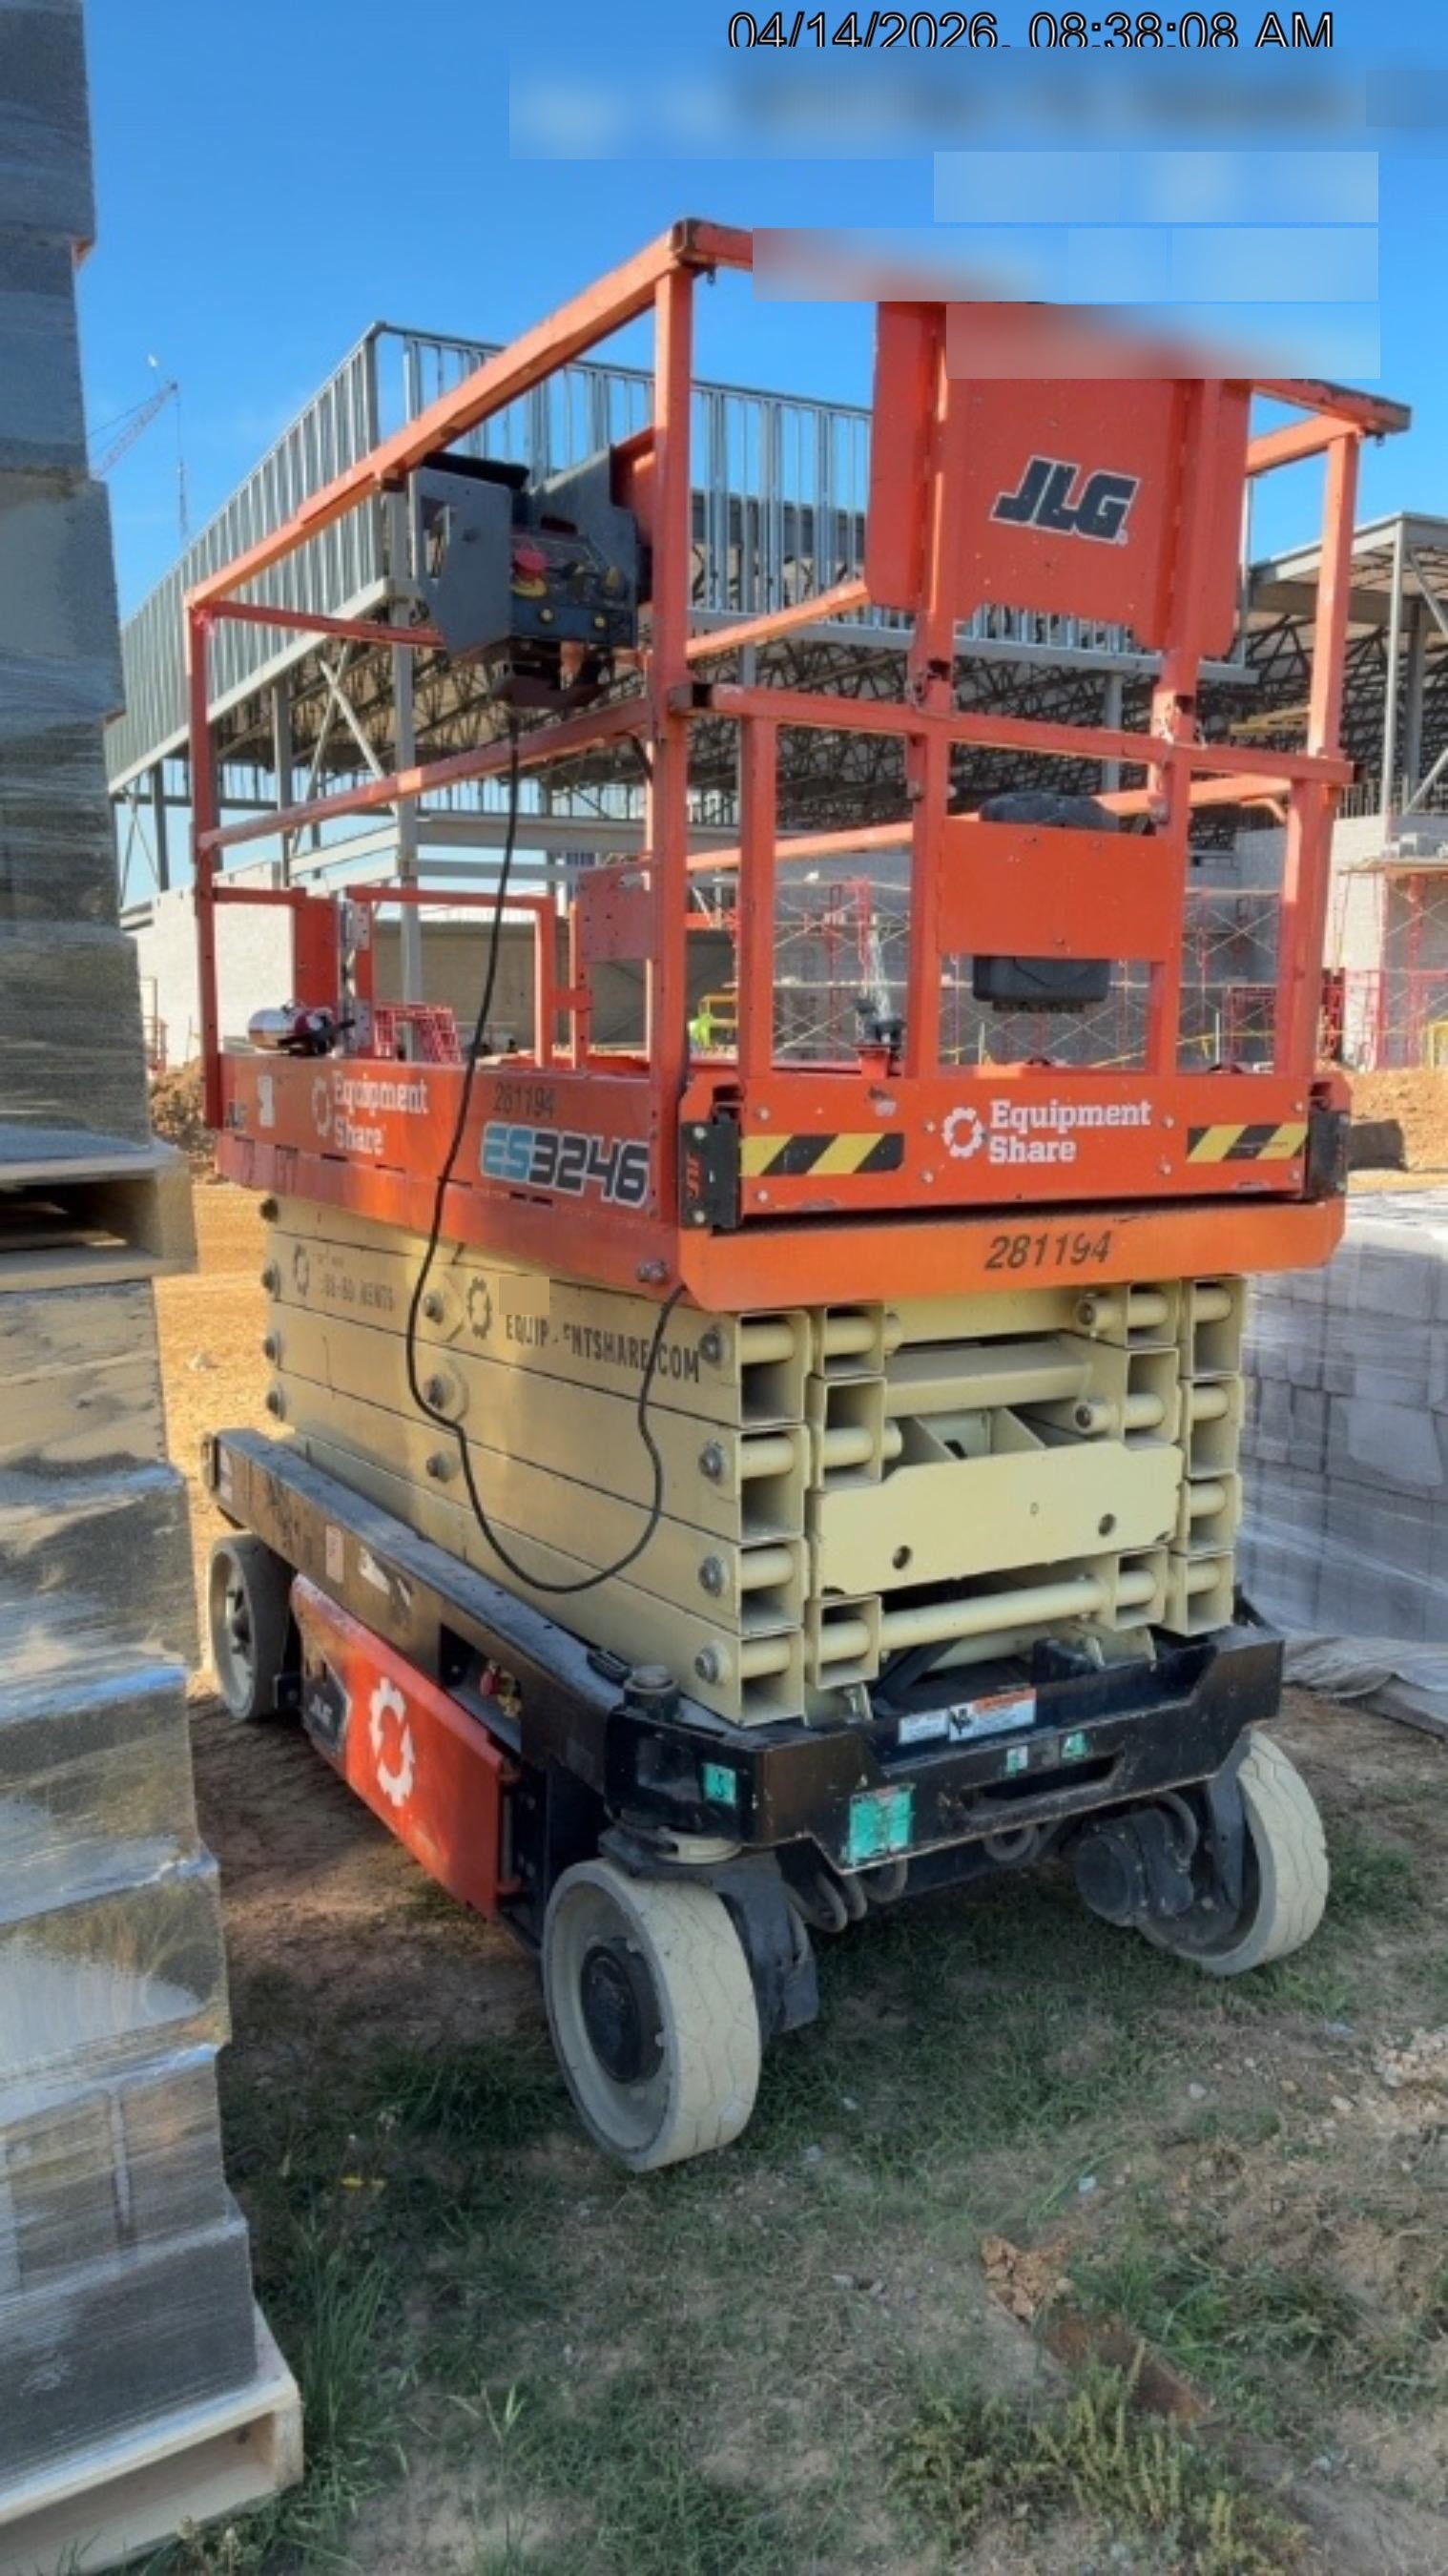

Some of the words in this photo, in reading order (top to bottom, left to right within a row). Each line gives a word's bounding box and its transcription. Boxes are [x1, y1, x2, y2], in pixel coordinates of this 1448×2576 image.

[989, 454, 1141, 546] JLG
[332, 1070, 429, 1117] Equipment
[335, 1114, 384, 1156] Share
[989, 1098, 1152, 1134] Equipment
[480, 1121, 650, 1208] ES3246
[988, 1135, 1077, 1164] Share
[984, 1230, 1112, 1271] 281194
